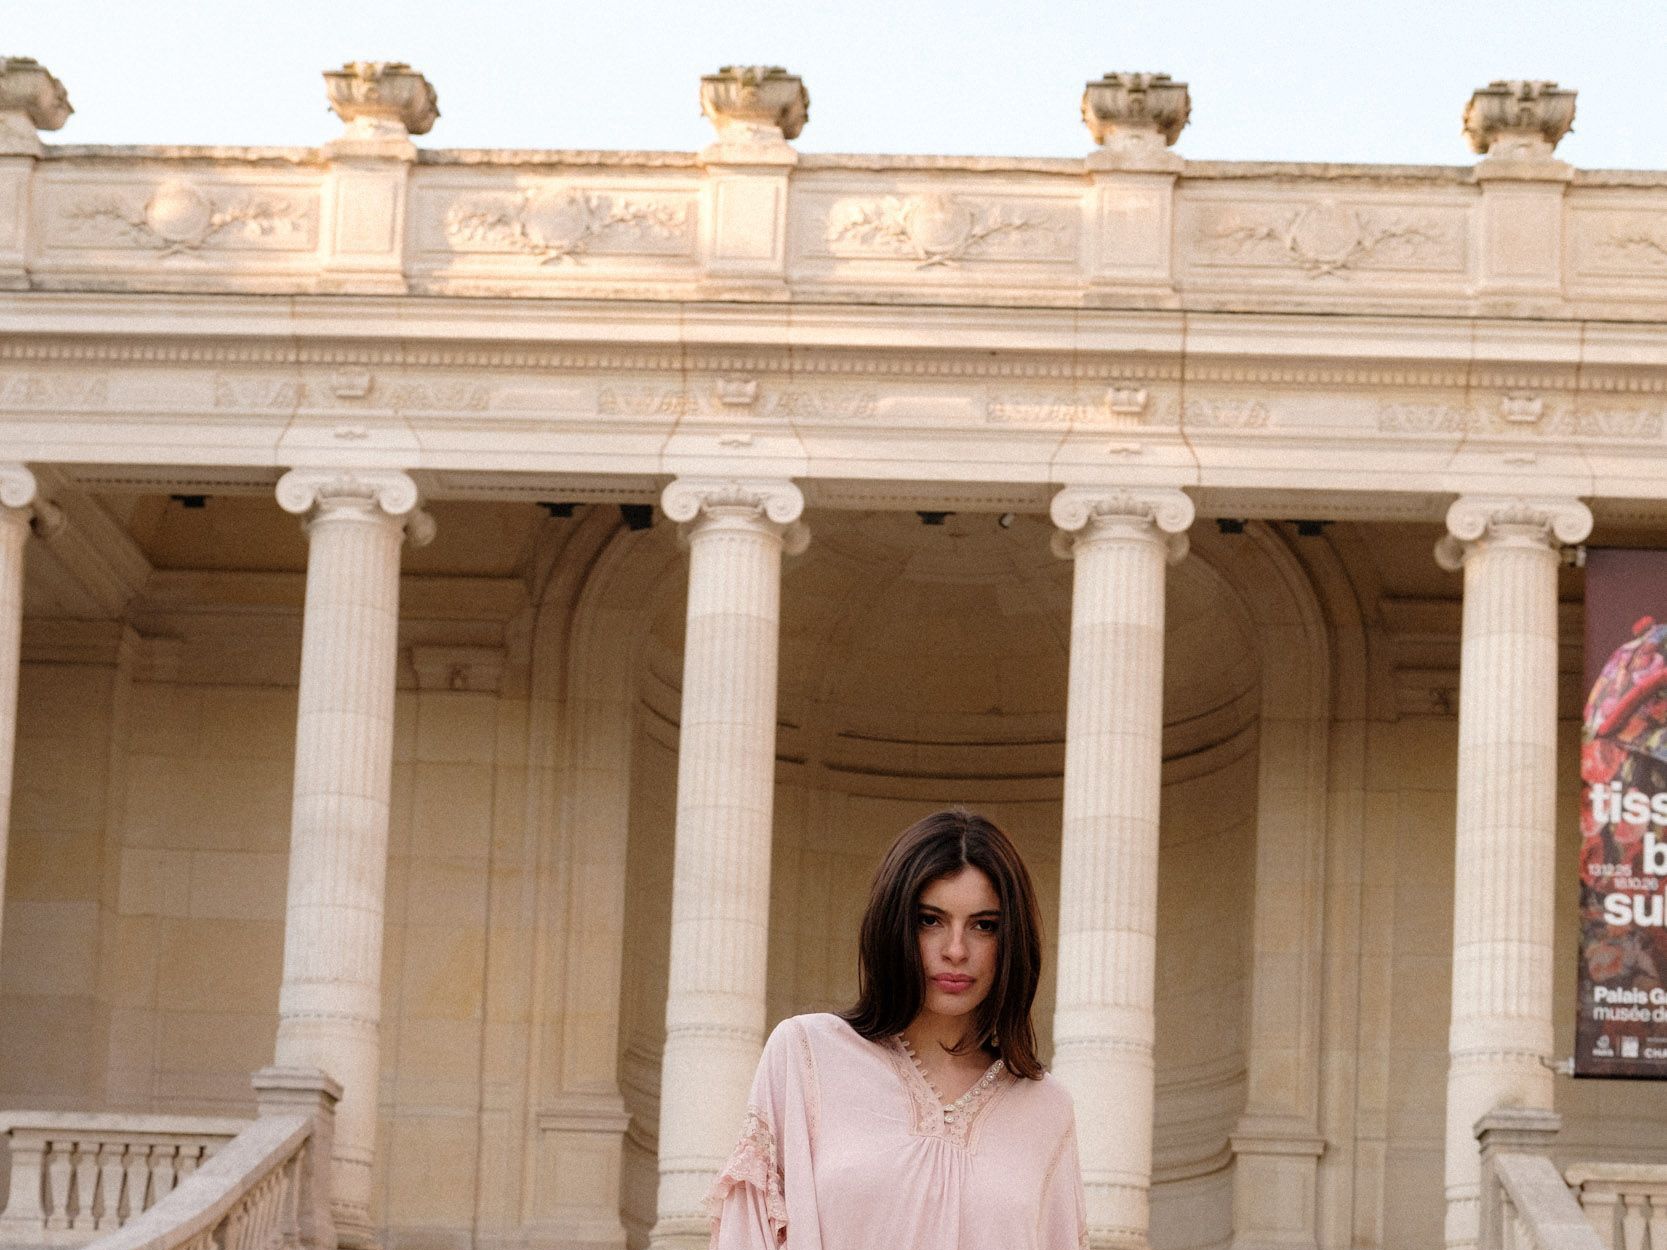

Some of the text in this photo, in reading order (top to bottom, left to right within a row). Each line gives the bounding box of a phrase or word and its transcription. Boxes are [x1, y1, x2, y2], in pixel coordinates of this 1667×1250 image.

[1643, 831, 1667, 876] b
[1603, 885, 1667, 927] su
[1594, 986, 1667, 1005] Palais G
[1593, 1004, 1651, 1022] musée
